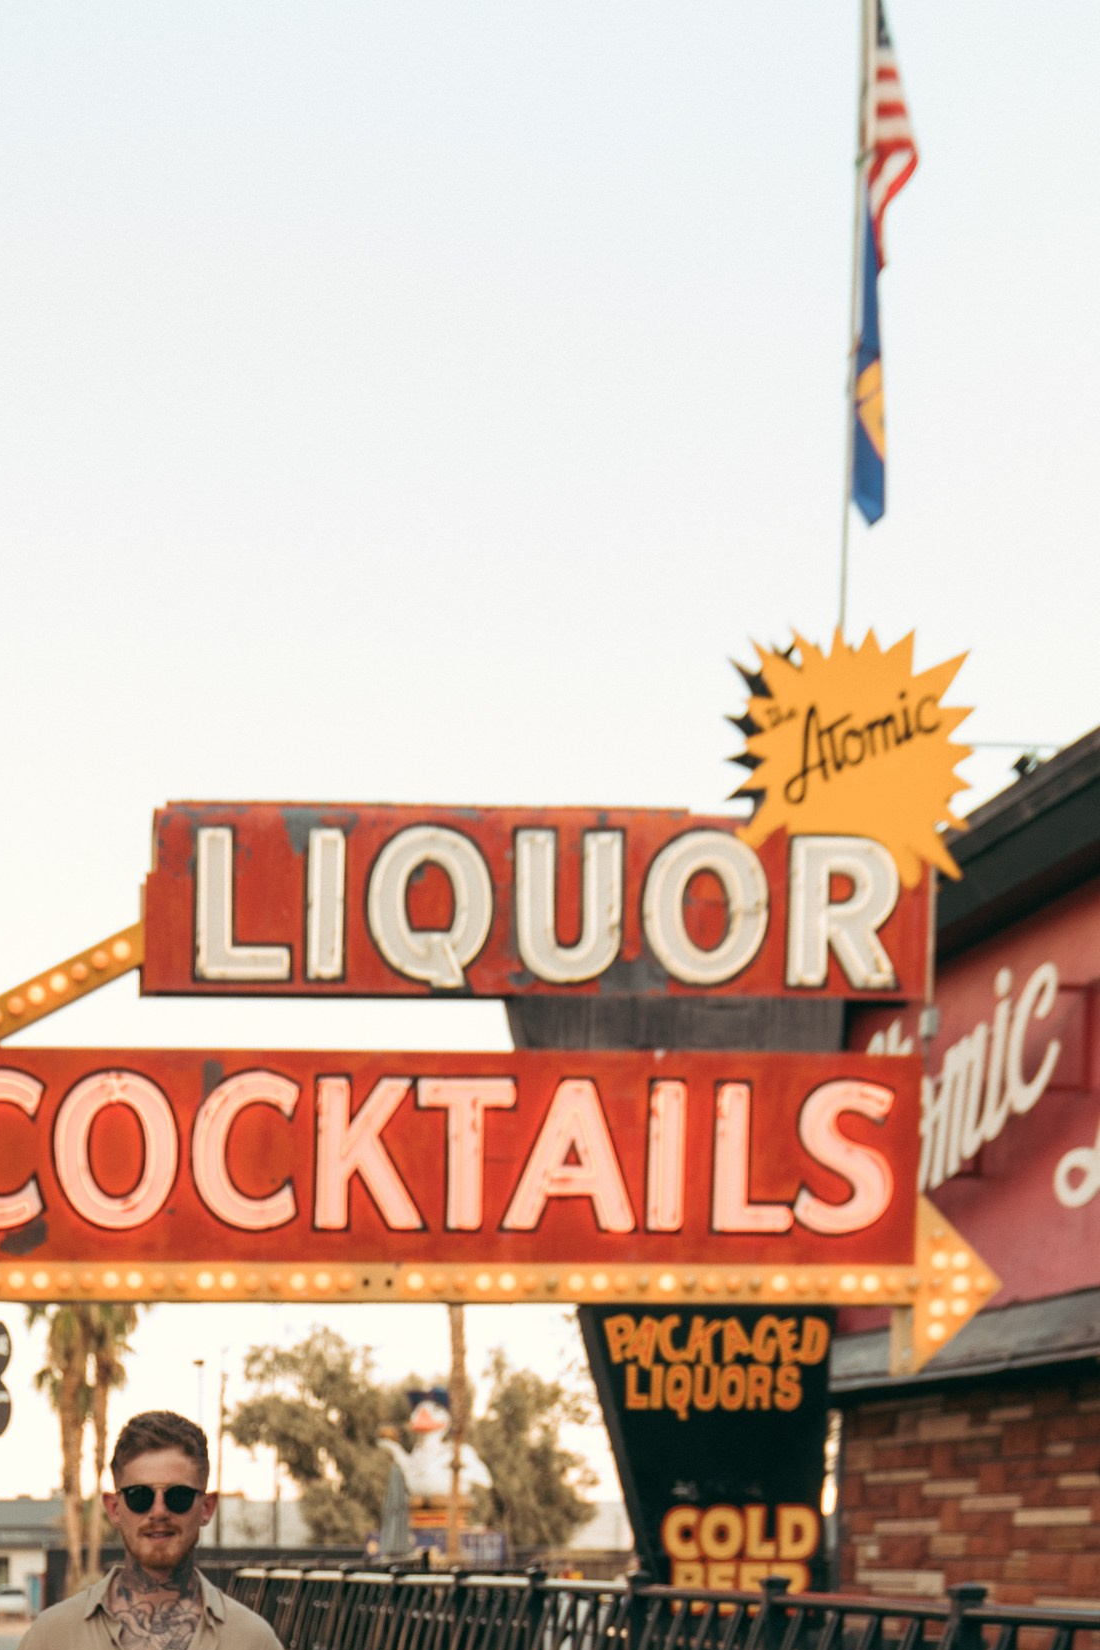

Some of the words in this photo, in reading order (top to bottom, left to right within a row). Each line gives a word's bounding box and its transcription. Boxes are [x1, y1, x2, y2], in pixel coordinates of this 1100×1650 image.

[784, 690, 943, 804] Atomic
[193, 824, 901, 991] LIQUOR
[917, 961, 1062, 1196] mic
[603, 1312, 831, 1371] PACKAGED
[624, 1362, 804, 1421] LIQUORS
[660, 1503, 821, 1562] COLD
